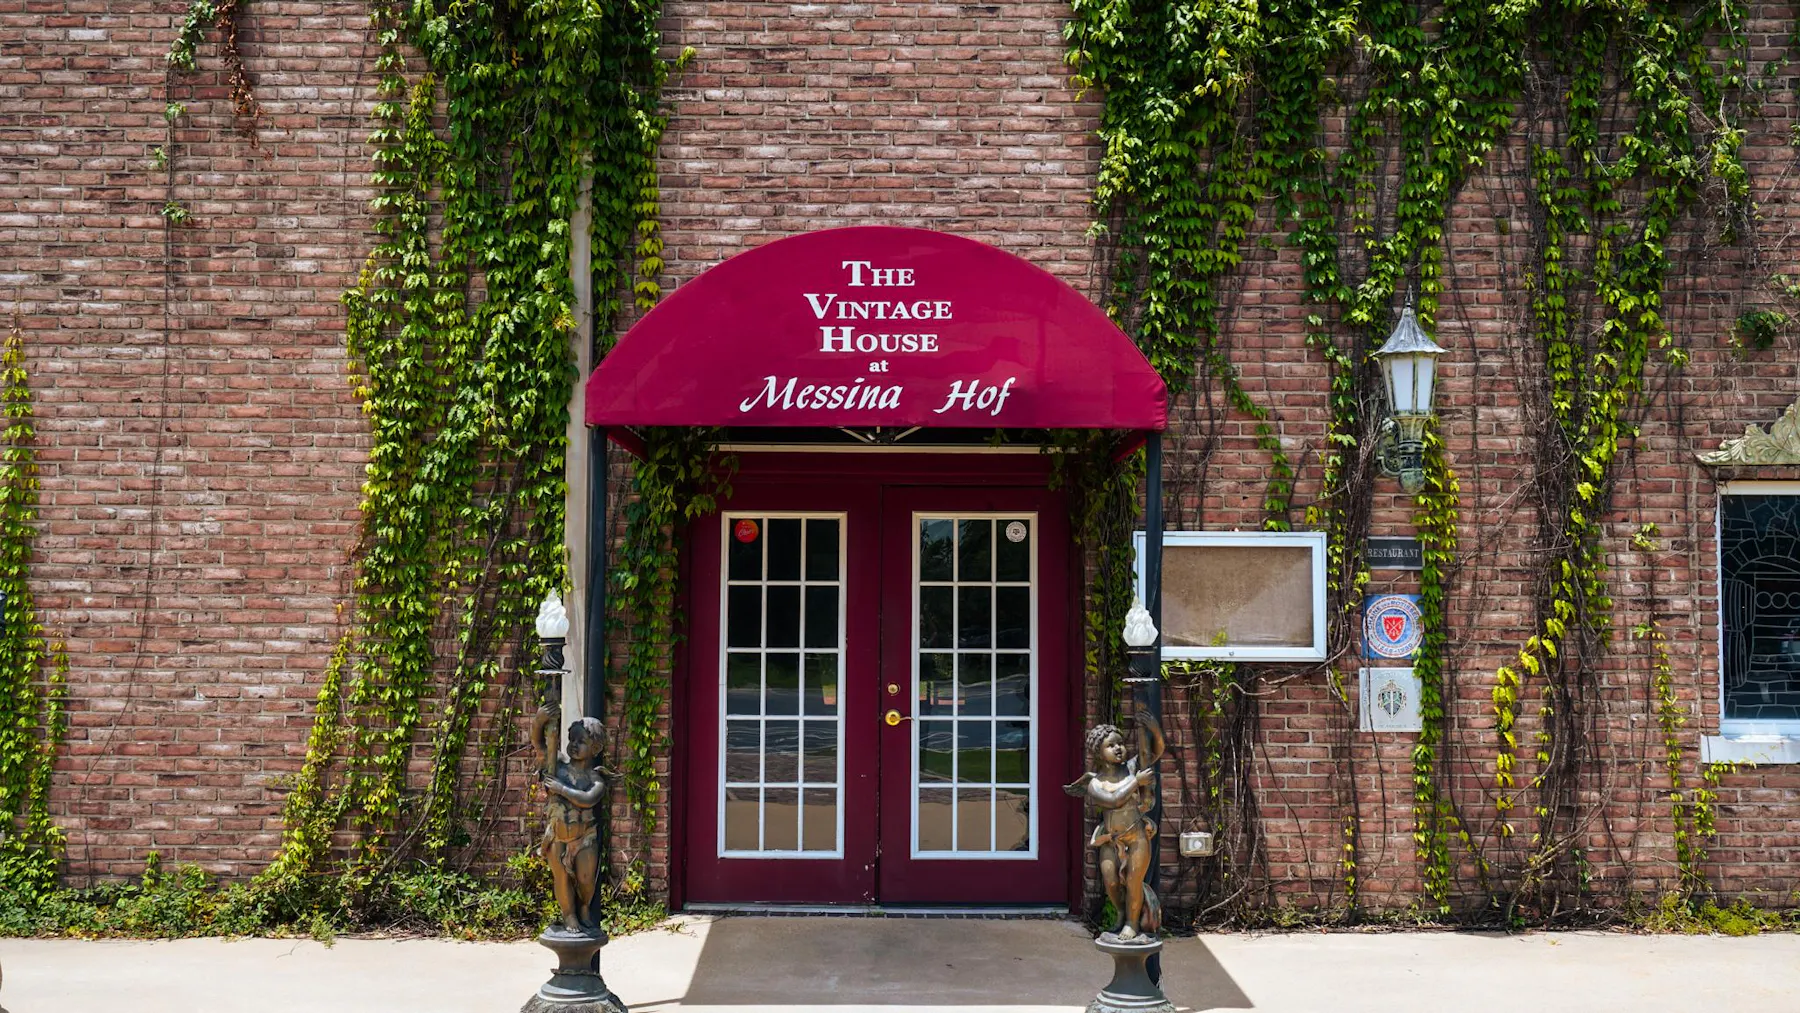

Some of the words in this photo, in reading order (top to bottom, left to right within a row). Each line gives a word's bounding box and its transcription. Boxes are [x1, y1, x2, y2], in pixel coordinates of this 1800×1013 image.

[842, 260, 915, 287] THE
[803, 293, 953, 320] VINTAGE
[819, 326, 939, 352] HOUSE
[868, 360, 889, 373] at
[739, 375, 904, 413] Messina
[933, 376, 1016, 417] Hof
[1367, 548, 1419, 558] RESTAURANT
